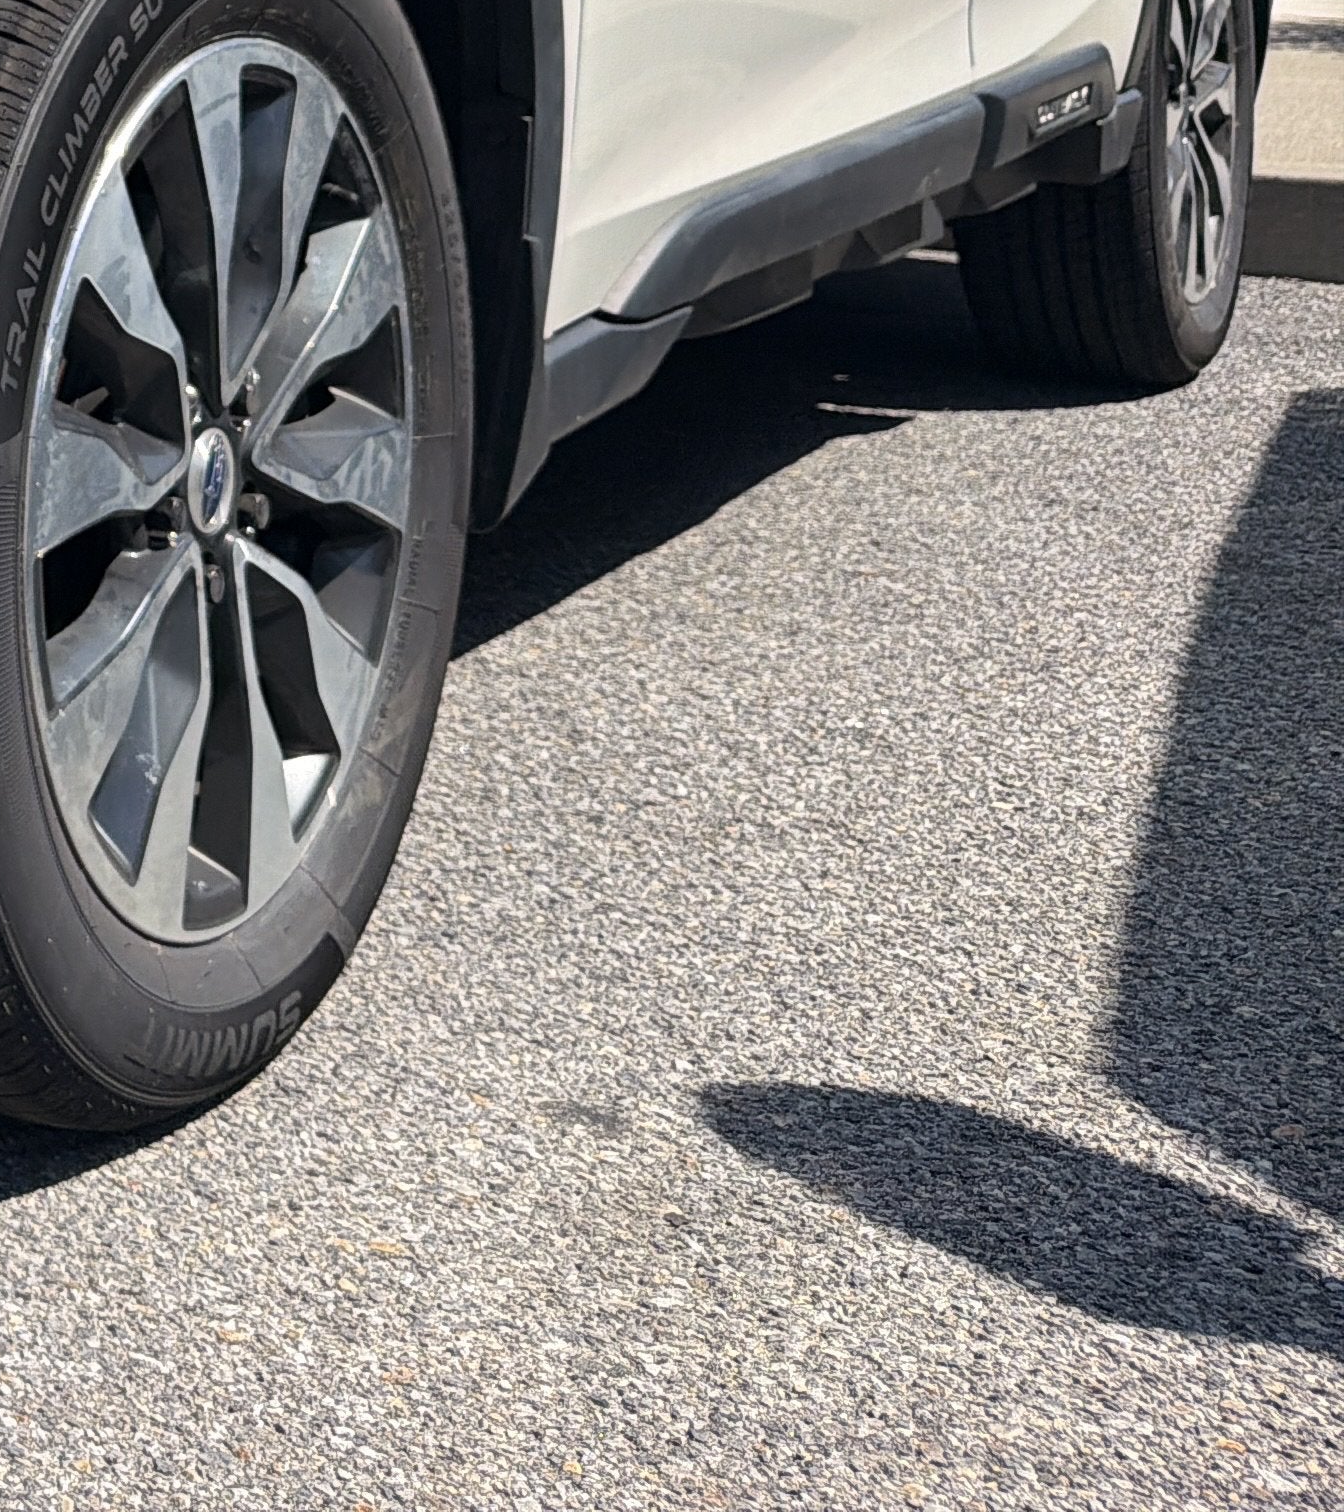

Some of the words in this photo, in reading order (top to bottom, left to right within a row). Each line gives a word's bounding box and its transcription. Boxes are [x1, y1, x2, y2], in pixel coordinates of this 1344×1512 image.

[0, 239, 48, 396] TRAIL
[40, 35, 129, 228] CLIMBER
[122, 990, 303, 1078] SUMMIT
